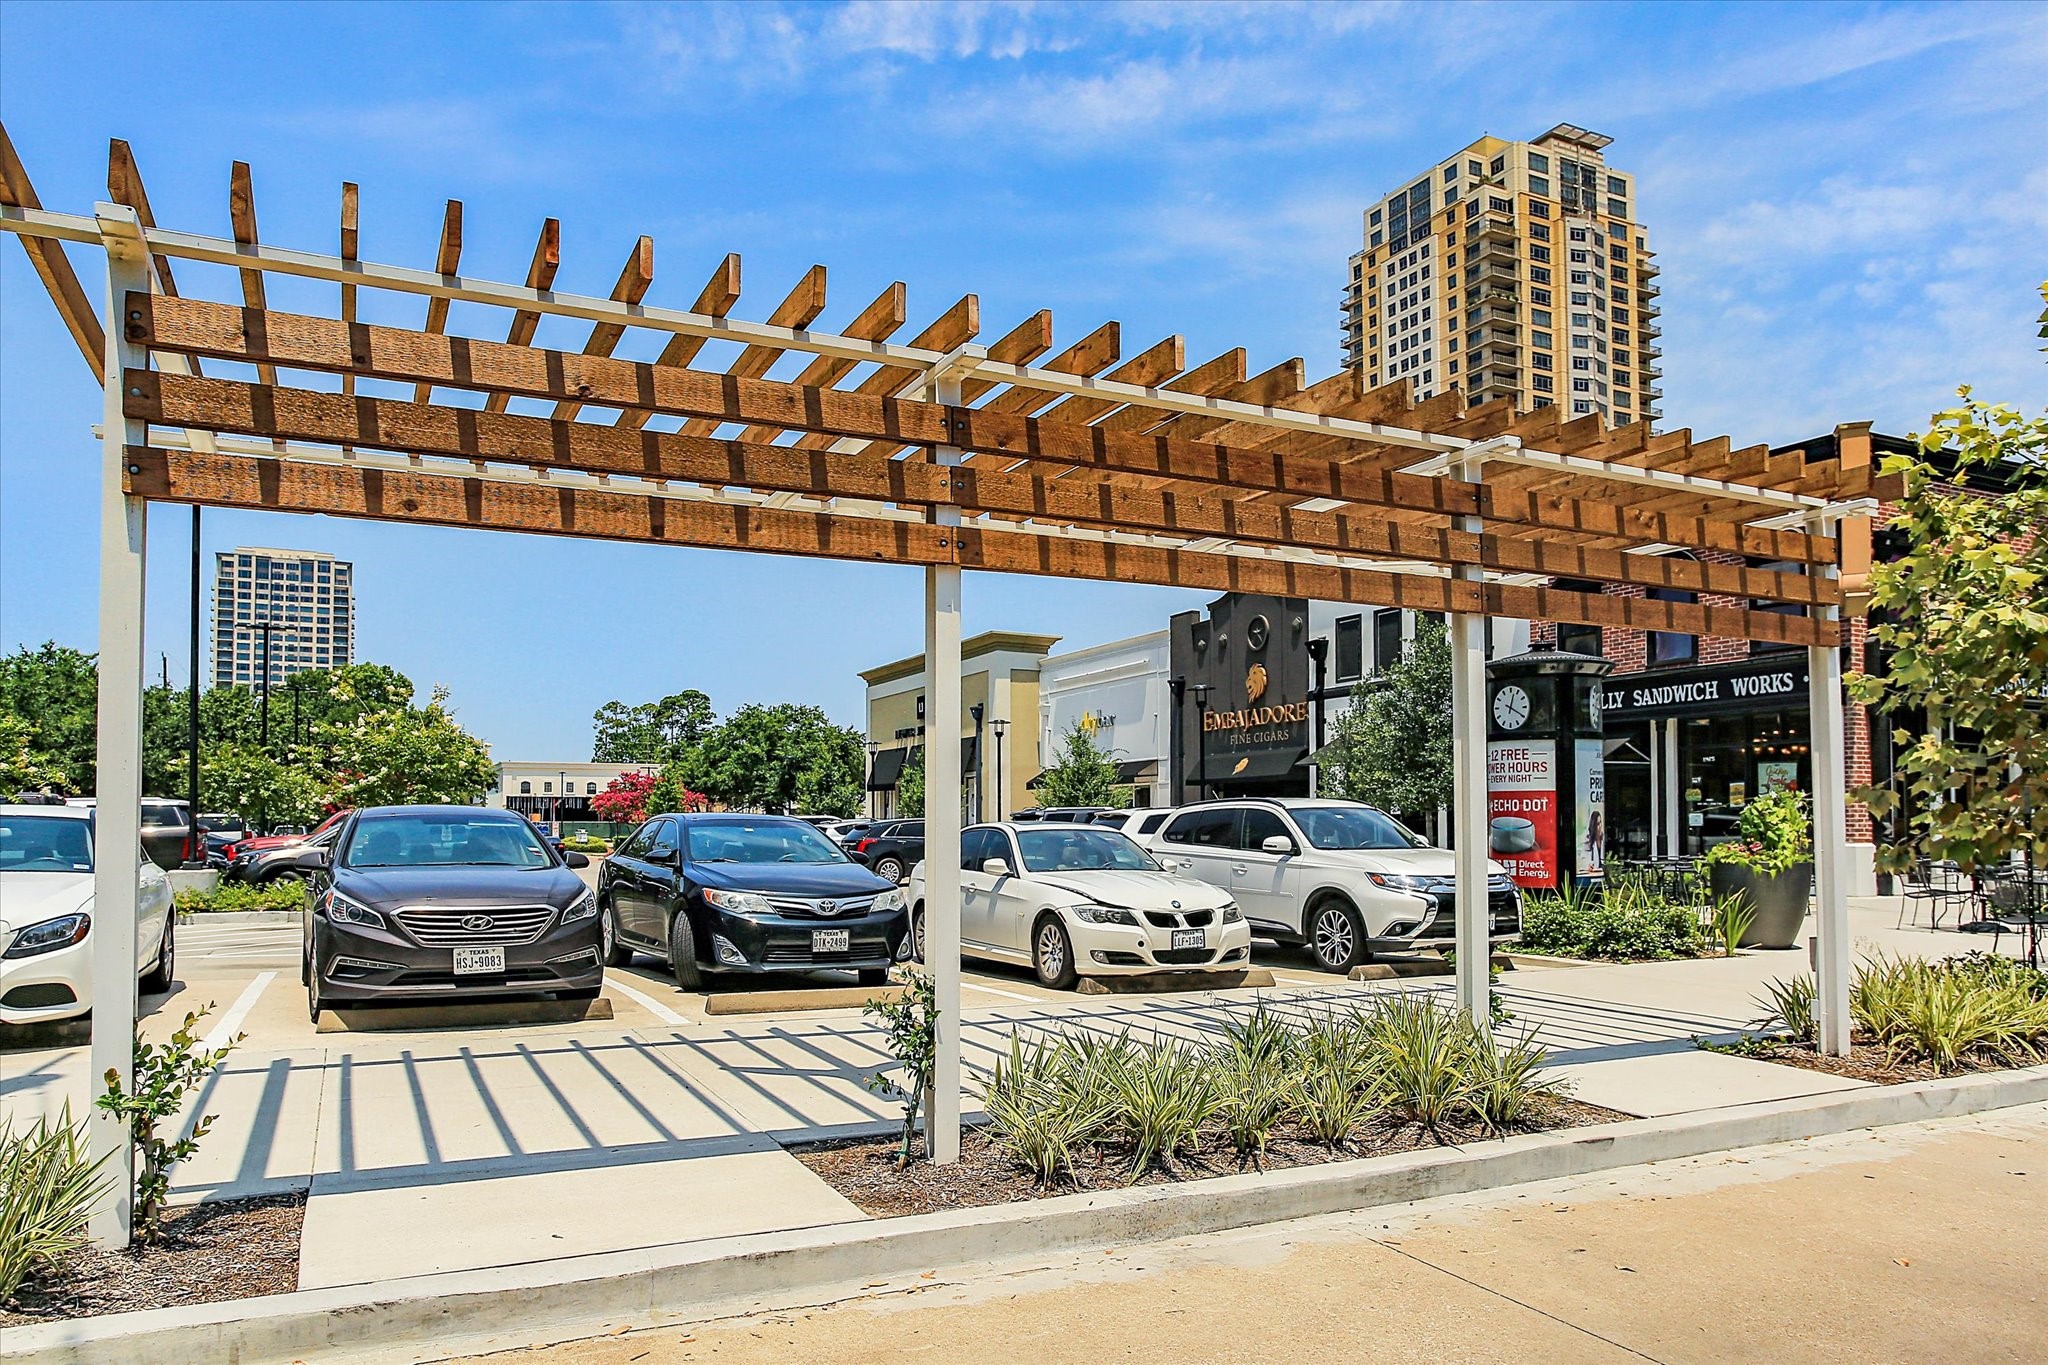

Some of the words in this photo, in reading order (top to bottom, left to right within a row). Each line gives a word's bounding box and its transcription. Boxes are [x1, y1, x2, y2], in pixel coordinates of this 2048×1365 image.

[1600, 691, 1625, 710] LLY
[1633, 680, 1718, 707] SANDWICH
[1731, 672, 1794, 697] WORKS
[1204, 701, 1310, 732] EMBAJADORE
[1230, 733, 1251, 745] FINE
[1253, 729, 1289, 743] CIGARS
[1491, 749, 1499, 762] 12
[1501, 748, 1530, 761] FREE
[1488, 763, 1506, 774] OWER
[1508, 761, 1548, 773] HOURS
[1490, 775, 1508, 784] EVERY
[1508, 774, 1532, 783] NIGHT
[1589, 777, 1604, 790] PRI
[1590, 791, 1604, 803] CAR
[1493, 799, 1520, 812] ECHO
[1523, 798, 1549, 812] DOT
[1518, 860, 1544, 869] Direct
